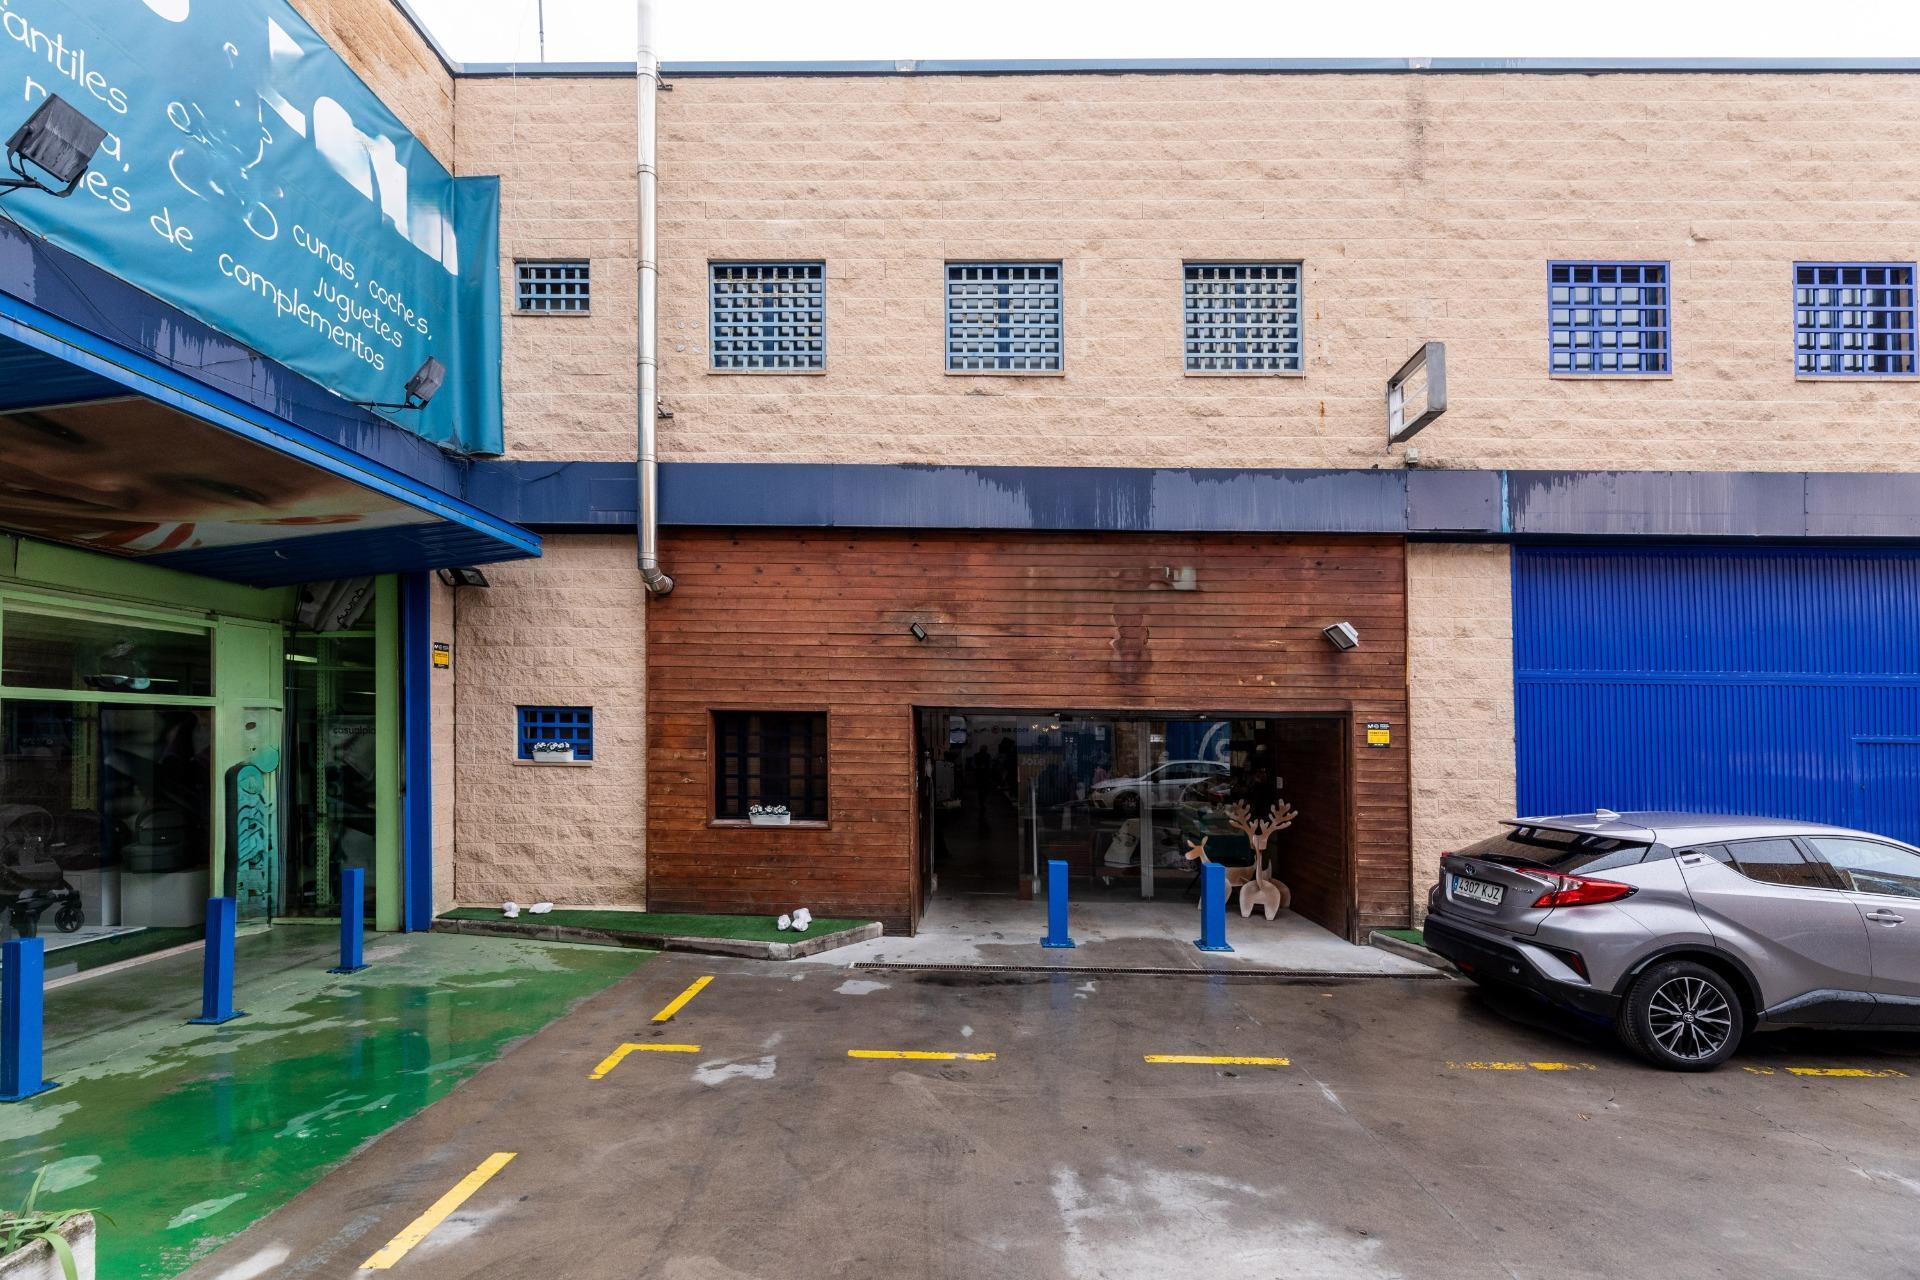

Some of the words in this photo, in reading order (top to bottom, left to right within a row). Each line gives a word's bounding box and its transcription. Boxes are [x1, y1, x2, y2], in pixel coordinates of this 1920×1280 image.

[150, 206, 194, 252] de
[218, 253, 385, 371] complementos
[292, 224, 359, 288] cunas,
[368, 280, 432, 341] coches,
[1459, 880, 1480, 894] 4307
[1481, 884, 1500, 900] KJZ
